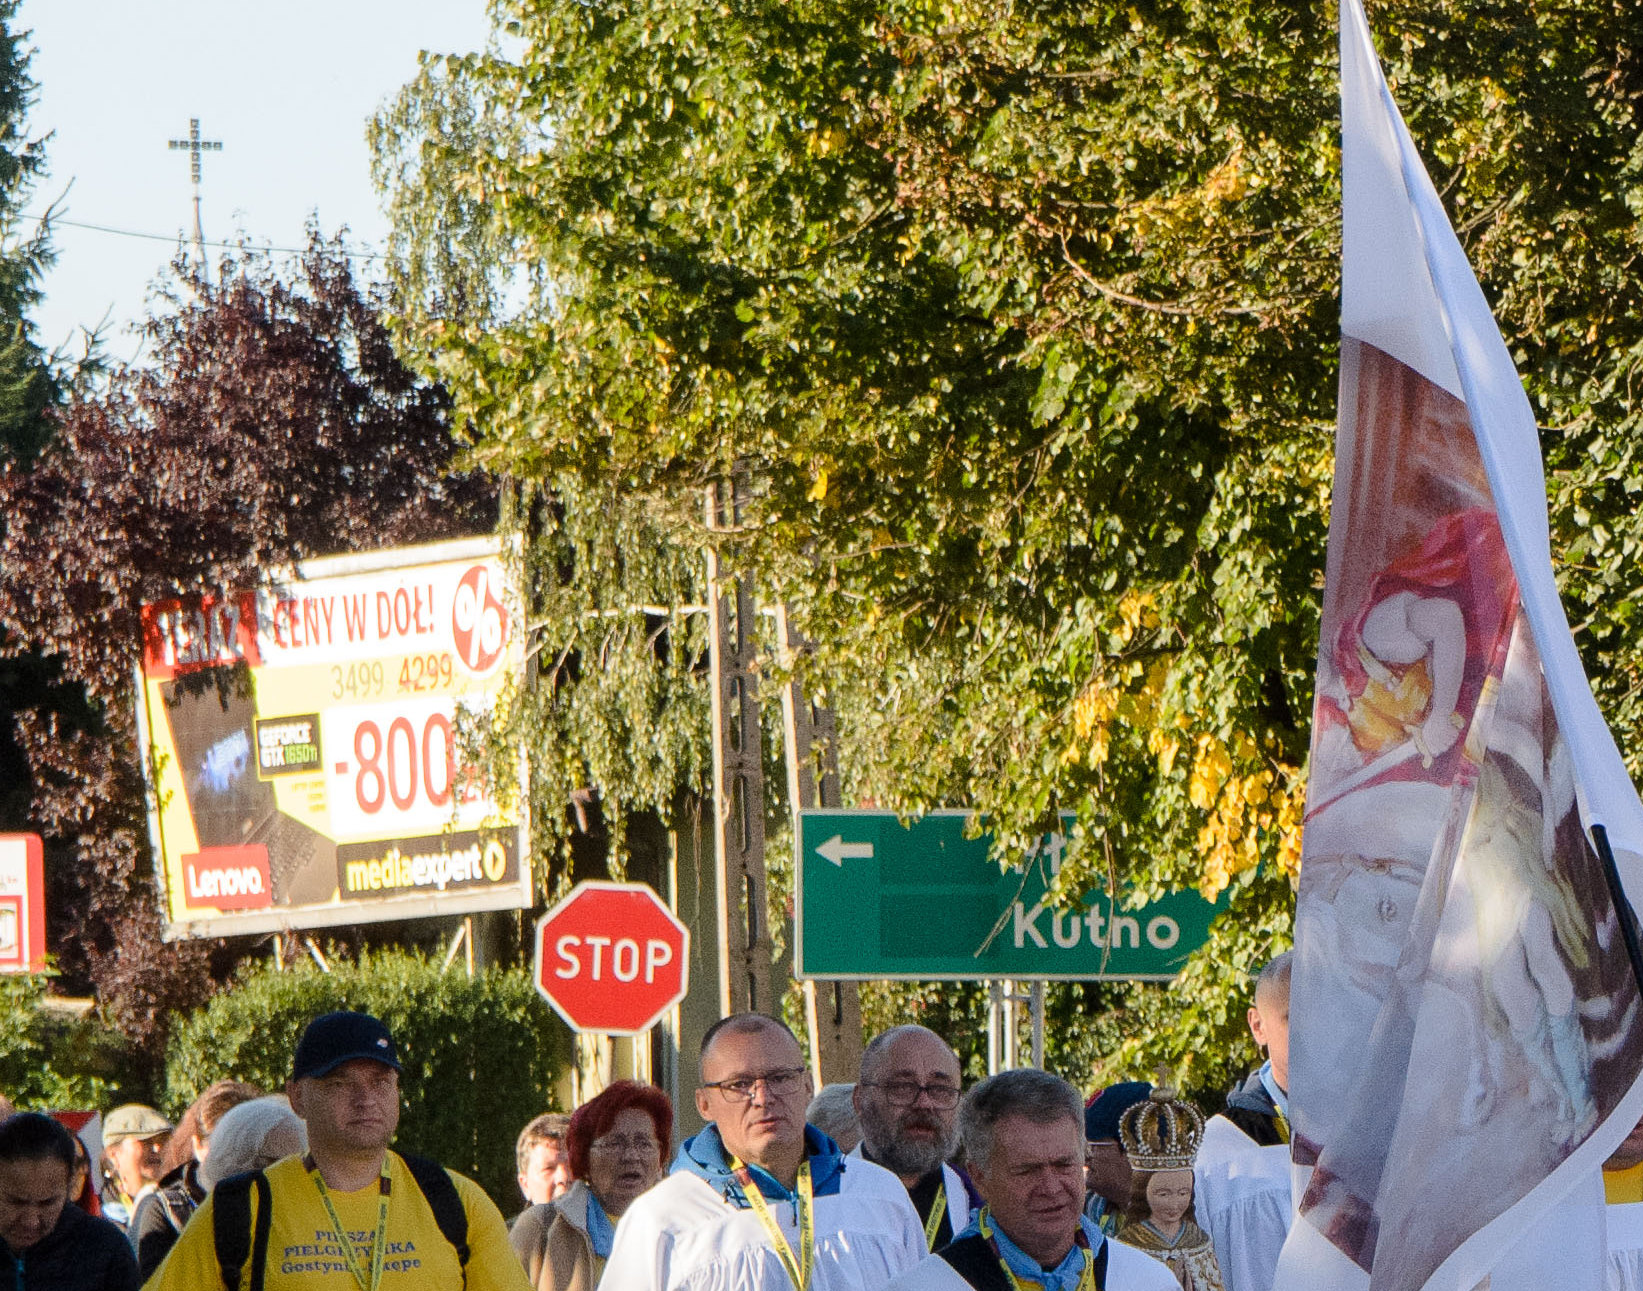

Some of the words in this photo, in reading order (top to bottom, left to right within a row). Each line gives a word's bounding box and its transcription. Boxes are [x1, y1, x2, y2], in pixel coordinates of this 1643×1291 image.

[343, 593, 367, 642] W
[331, 661, 384, 699] 3499
[398, 653, 452, 692] 4299
[188, 864, 263, 898] Lenovo
[345, 842, 483, 891] mediaexpert
[1013, 900, 1181, 950] Kutno
[554, 935, 673, 985] STOP
